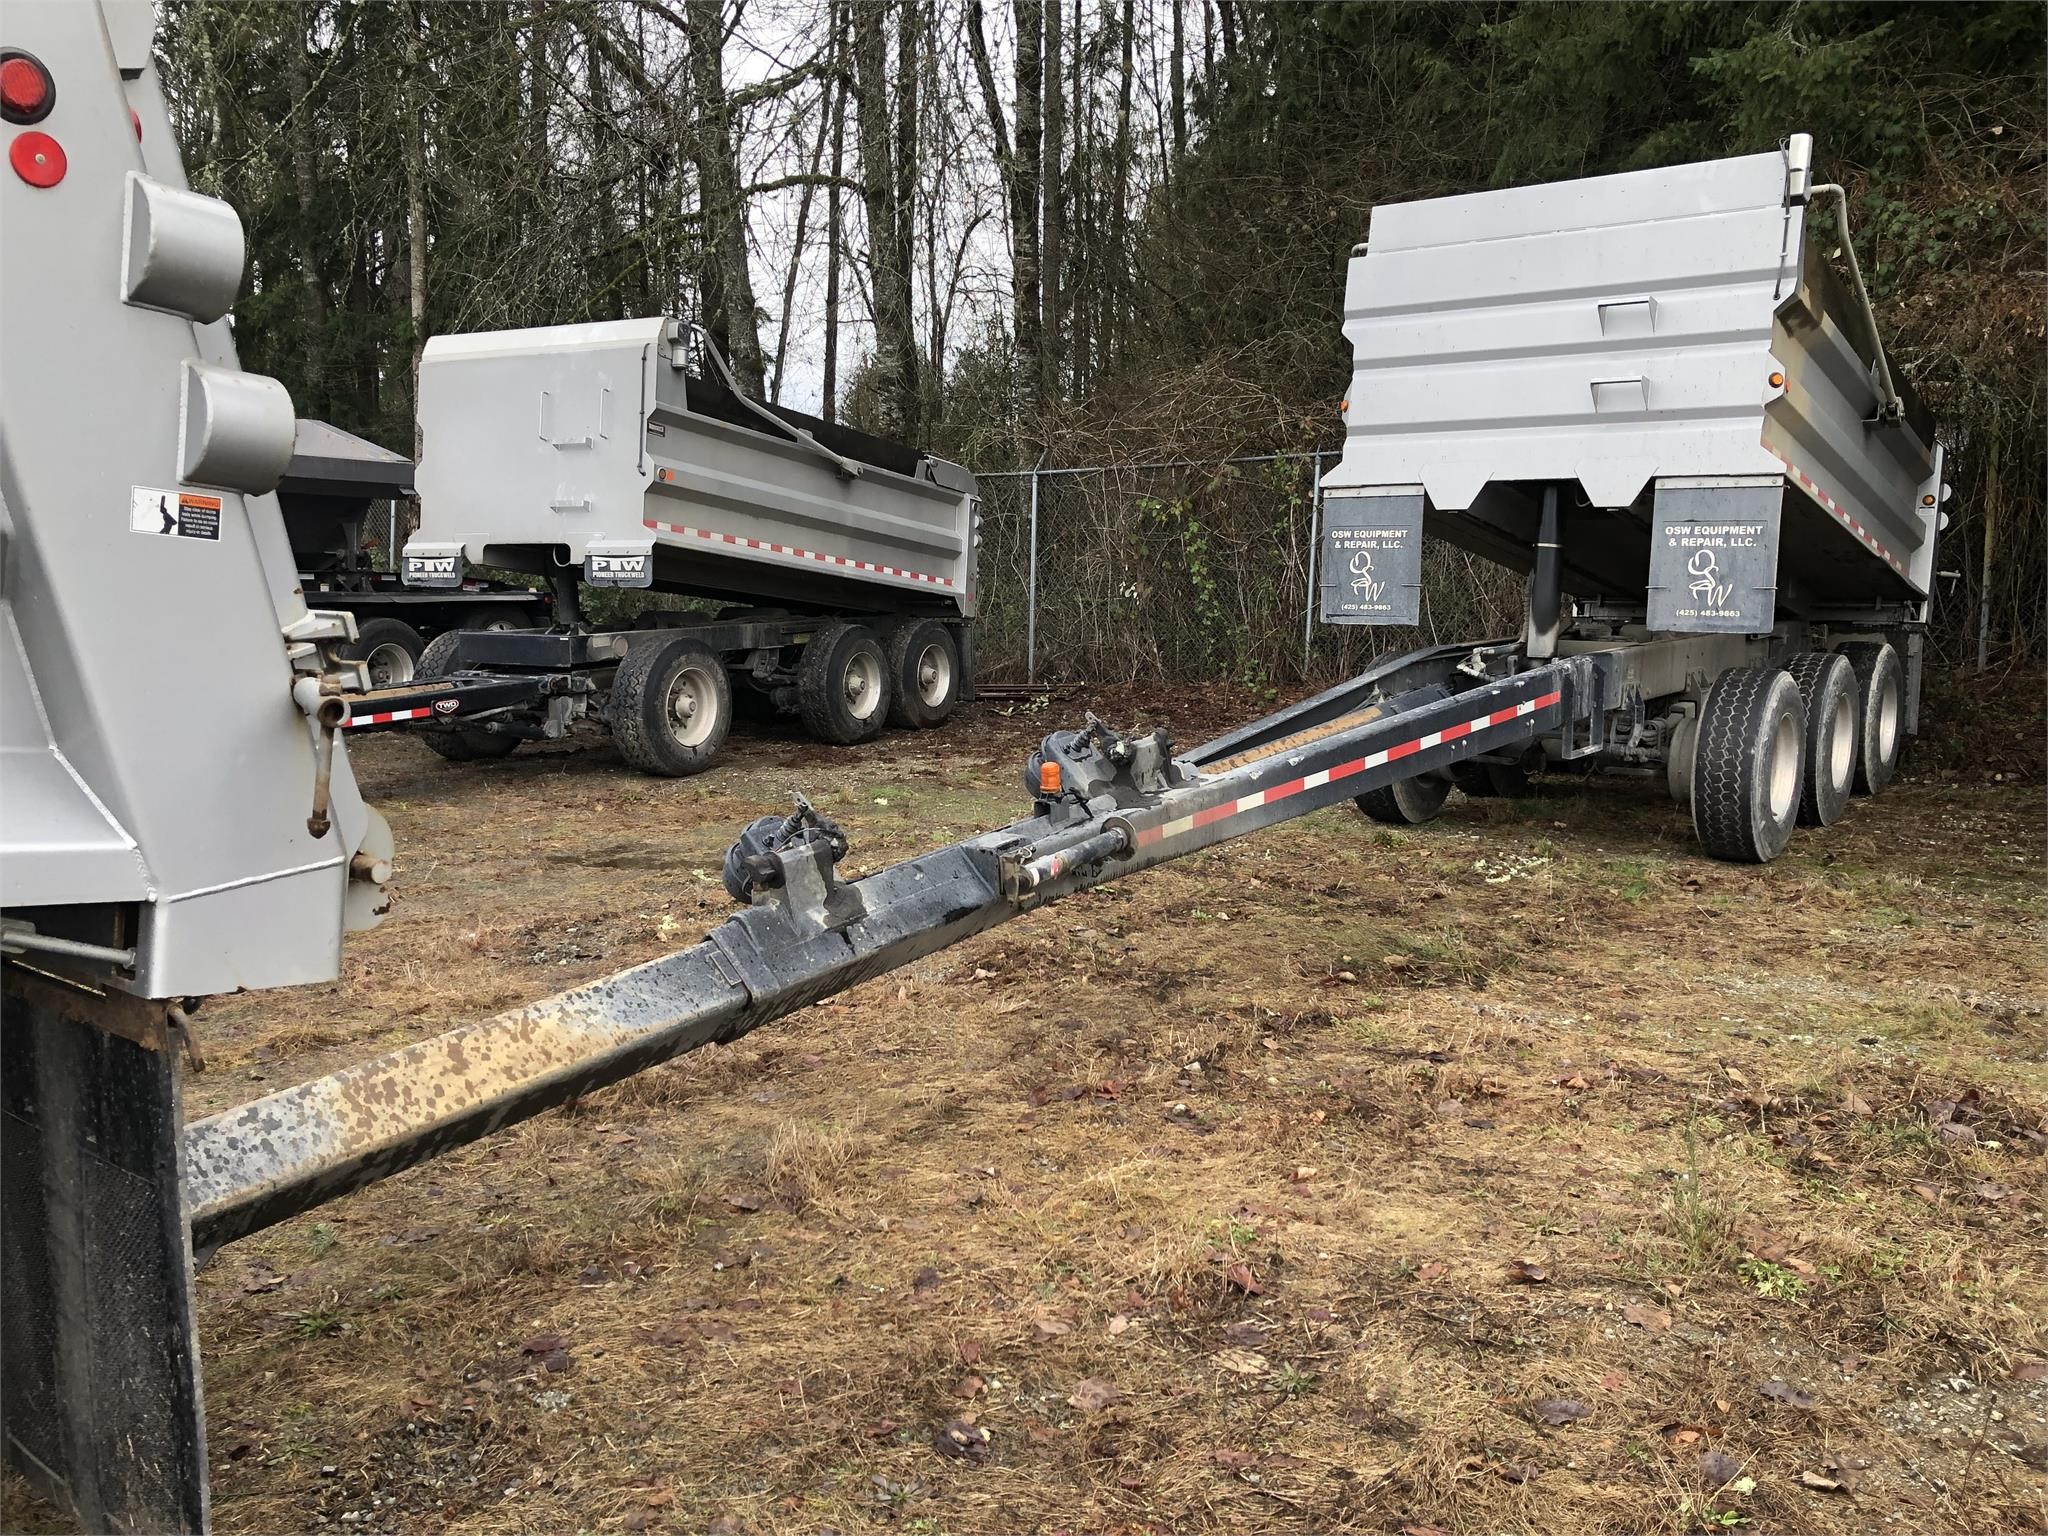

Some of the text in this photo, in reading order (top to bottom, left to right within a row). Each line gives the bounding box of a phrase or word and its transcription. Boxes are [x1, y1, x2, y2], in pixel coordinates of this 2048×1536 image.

[1331, 530, 1408, 539] OSW EQUIPMENT
[1665, 526, 1763, 535] OSW EQUIPMENT
[1334, 540, 1403, 550] & REPAIR, LLC.
[1668, 538, 1757, 548] & REPAIR, LLC.
[408, 557, 455, 572] PTW
[591, 556, 645, 571] PTW
[1675, 609, 1698, 617] (425)
